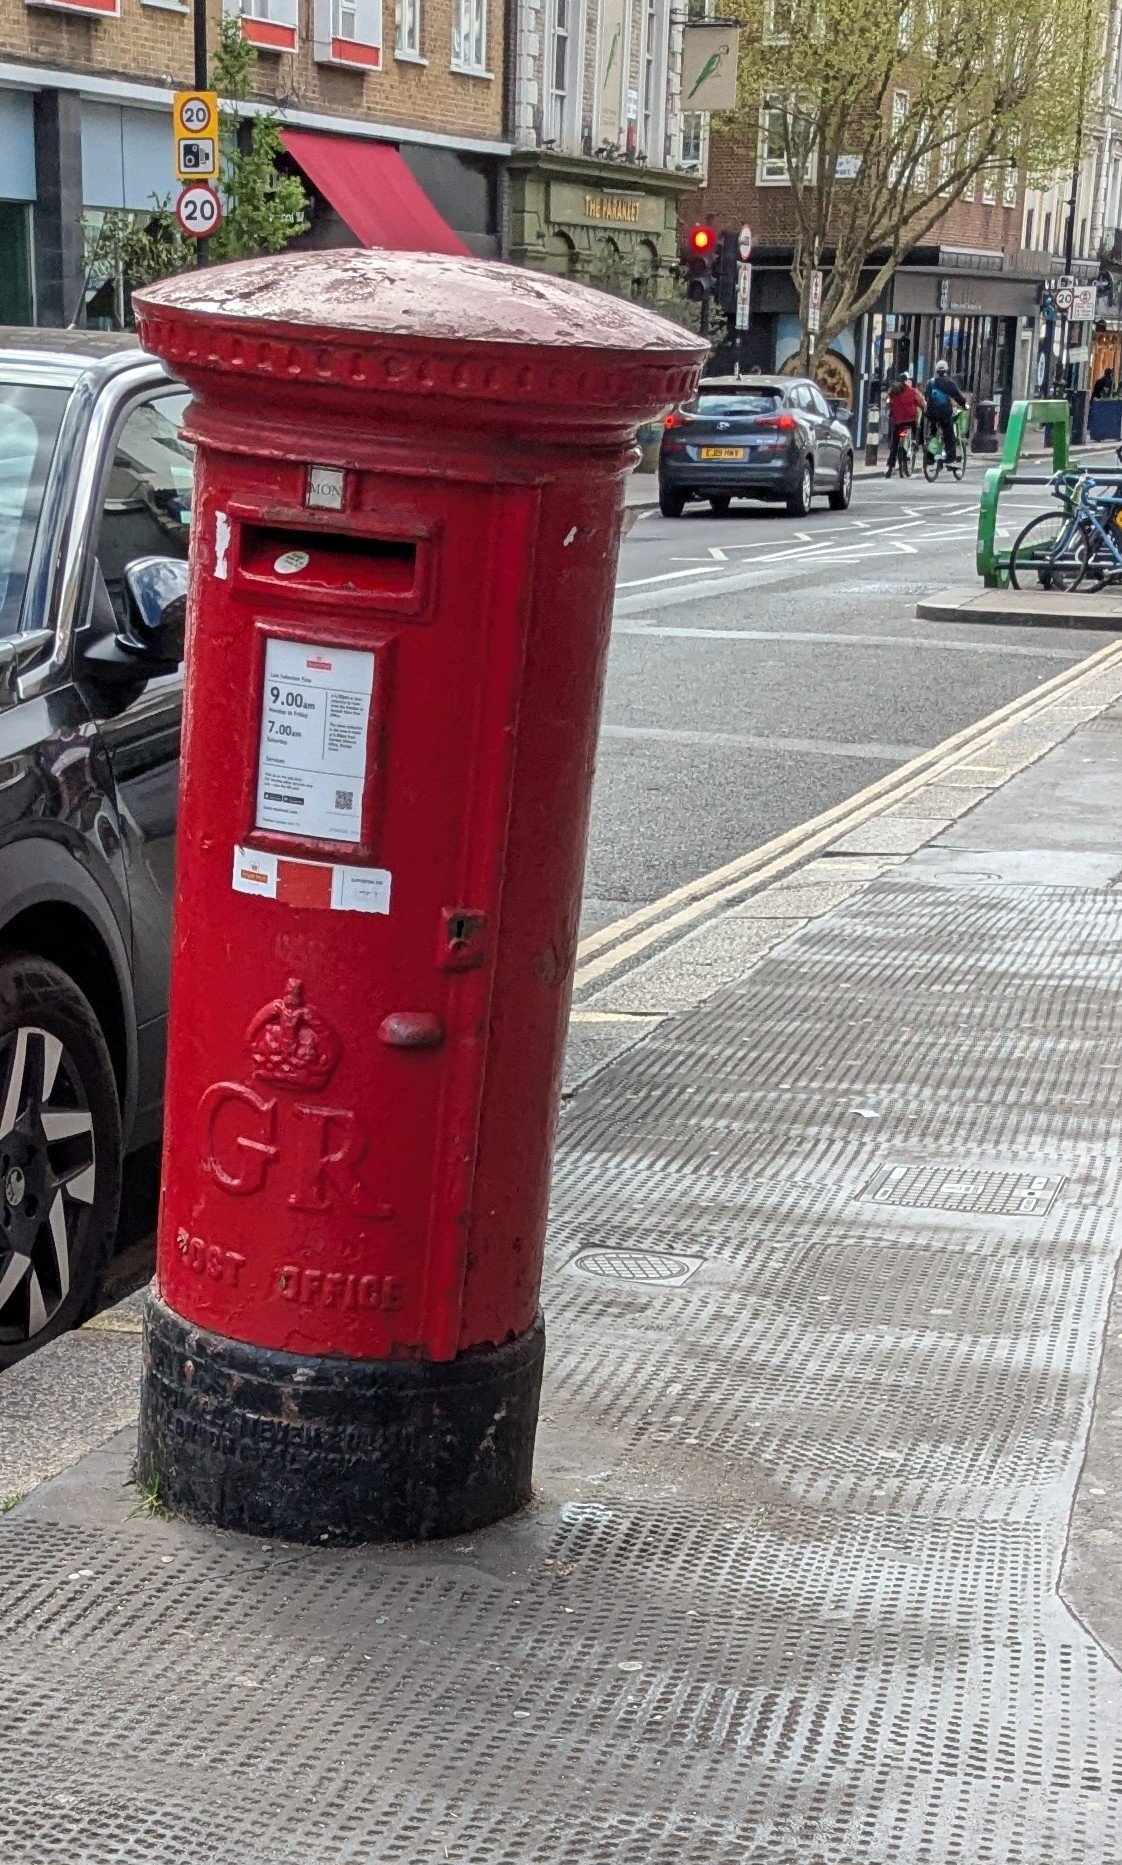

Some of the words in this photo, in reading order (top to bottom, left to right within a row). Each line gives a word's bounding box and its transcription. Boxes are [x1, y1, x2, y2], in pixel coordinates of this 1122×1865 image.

[185, 107, 207, 123] 20
[184, 199, 215, 221] 20
[584, 194, 601, 218] THE
[602, 198, 640, 222] PARAKEET
[1058, 294, 1072, 304] 20
[308, 482, 341, 497] MON
[275, 1264, 402, 1313] OFFICE
